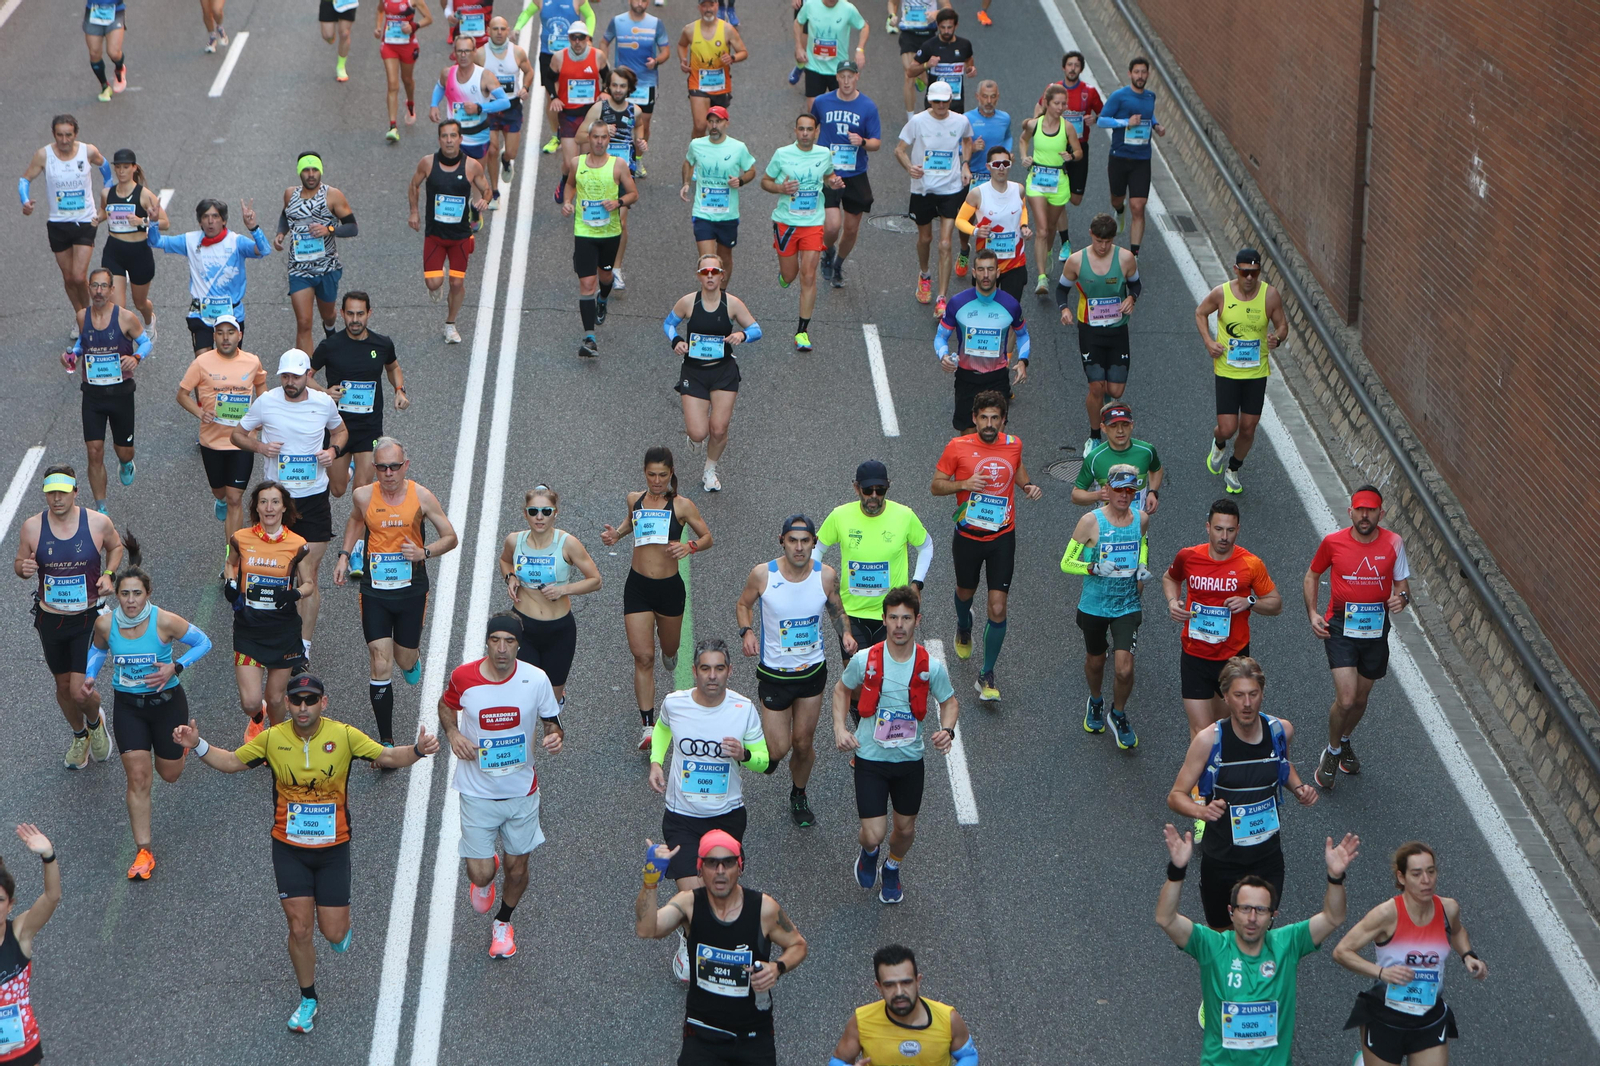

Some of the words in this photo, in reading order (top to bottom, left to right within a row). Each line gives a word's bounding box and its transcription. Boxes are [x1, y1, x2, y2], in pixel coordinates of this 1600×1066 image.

[825, 109, 860, 127] DUKE
[56, 180, 84, 188] SAMBA
[983, 497, 1004, 505] ZURICH
[981, 507, 994, 515] 6349
[977, 514, 994, 522] IGNACIO
[1189, 574, 1238, 592] CORRALES
[1203, 608, 1225, 616] ZURICH
[794, 618, 815, 627] ZURICH
[1197, 626, 1219, 635] CORRALES
[495, 738, 520, 746] ZURICH
[496, 752, 511, 760] 5423
[500, 758, 520, 767] BATISTA
[699, 764, 725, 772] ZURICH
[1248, 802, 1271, 814] ZURICH
[1249, 818, 1264, 828] 5625
[297, 829, 325, 837] LOURENÇO
[1249, 827, 1266, 836] KLAAS
[715, 952, 745, 962] ZURICH
[1406, 954, 1440, 964] RTC
[714, 966, 731, 976] 3241
[708, 975, 718, 983] SR.
[719, 977, 737, 986] MORA
[1226, 971, 1242, 989] 13
[1414, 972, 1435, 980] URICH
[1241, 1005, 1271, 1014] ZURICH
